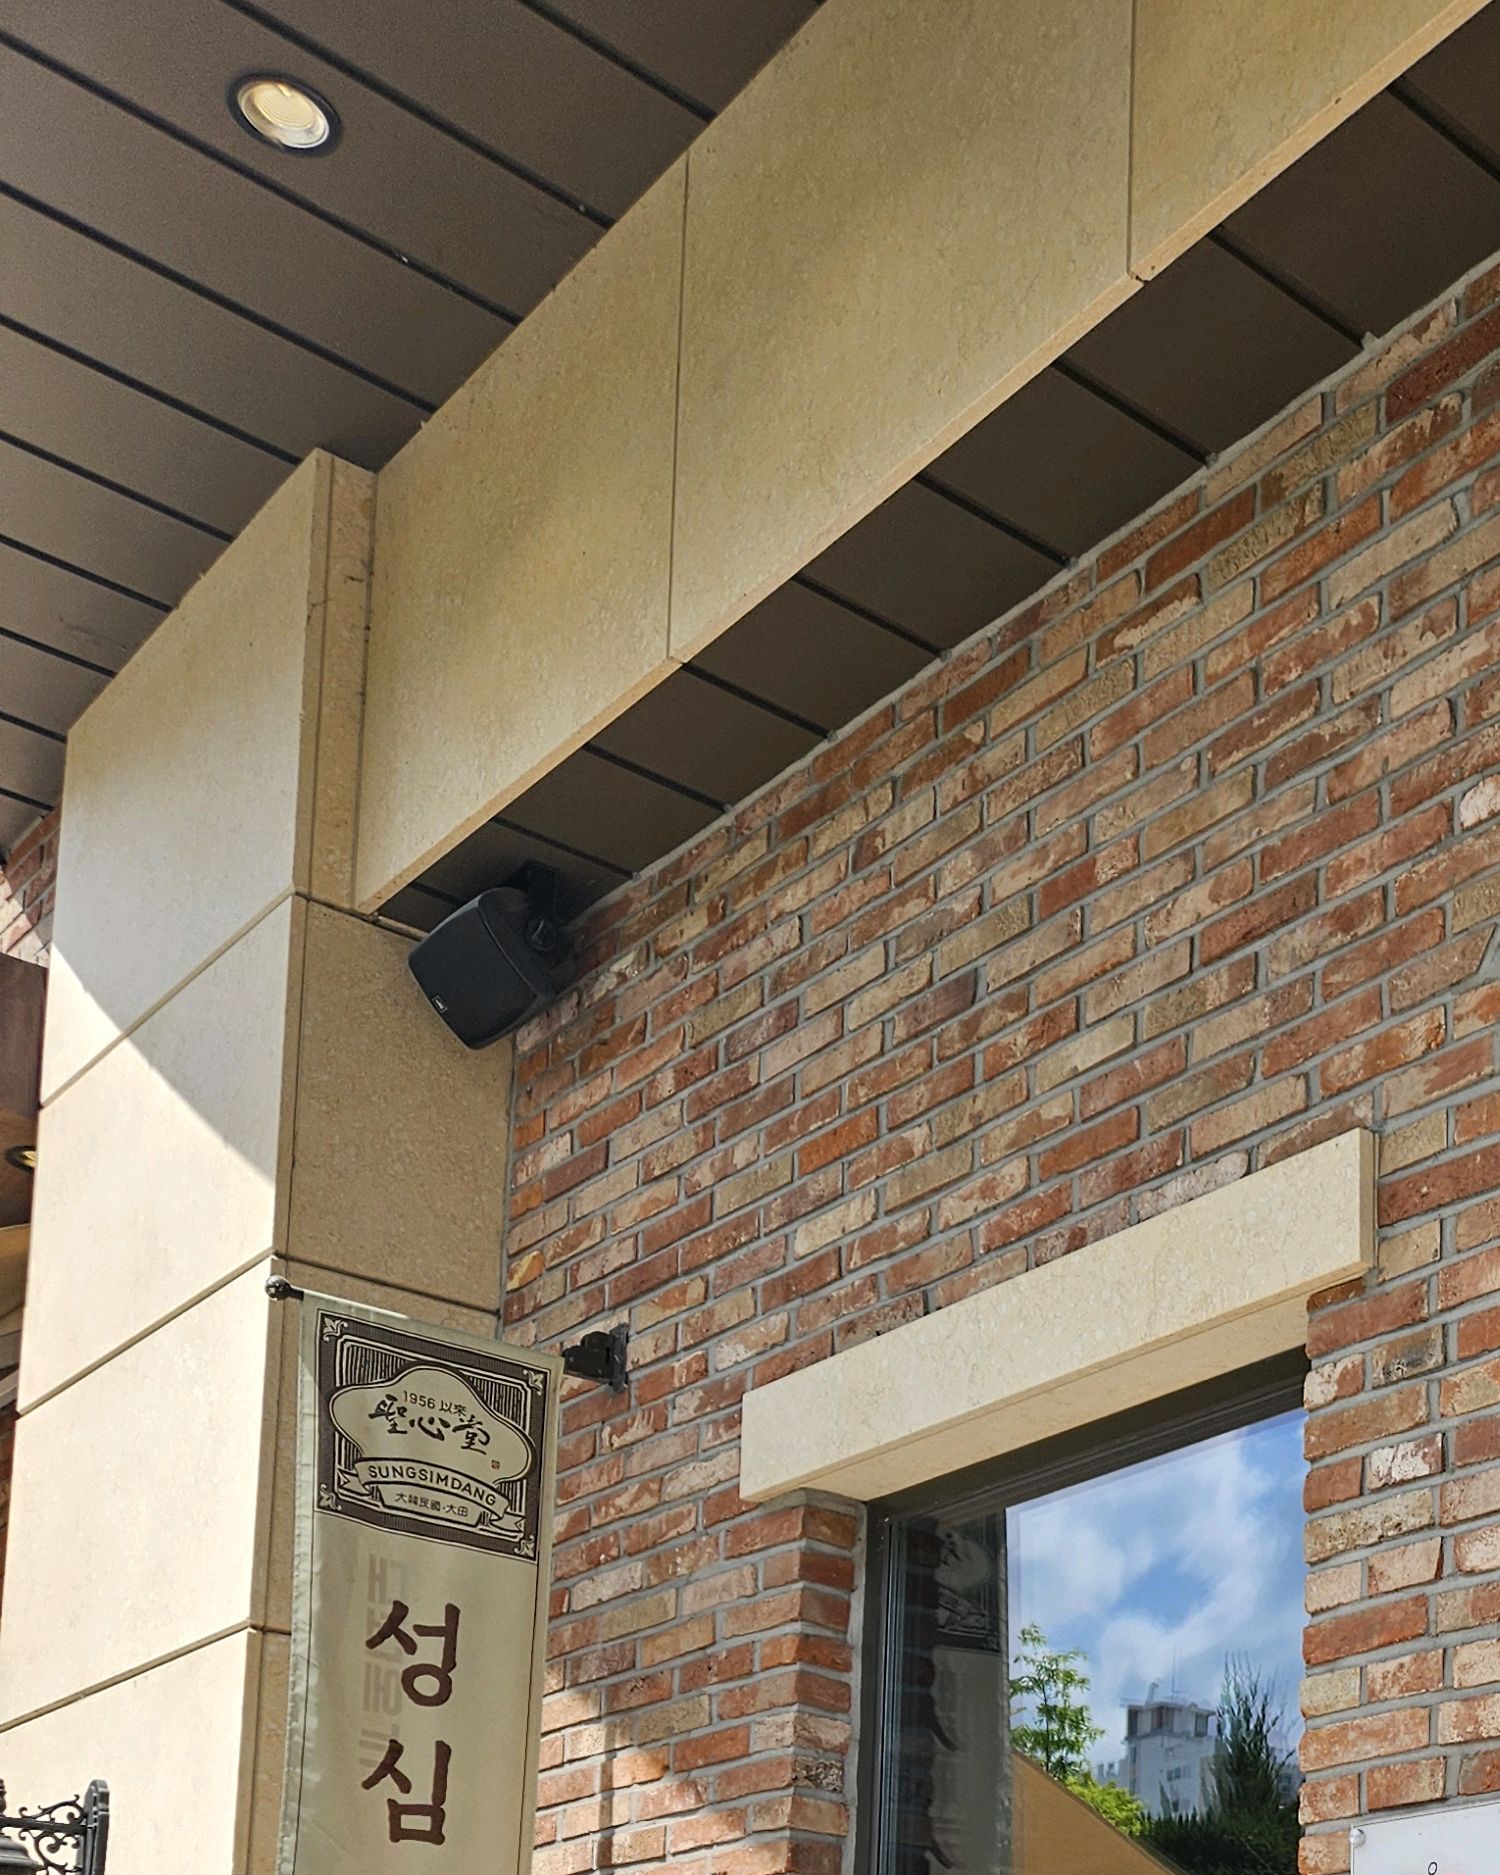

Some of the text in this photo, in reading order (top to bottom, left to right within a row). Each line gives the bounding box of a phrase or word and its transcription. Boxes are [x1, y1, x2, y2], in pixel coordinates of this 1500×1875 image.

[403, 1391, 467, 1417] 1956 以來
[368, 1394, 491, 1456] 聖心堂
[368, 1465, 496, 1506] SUNGSIMDANG
